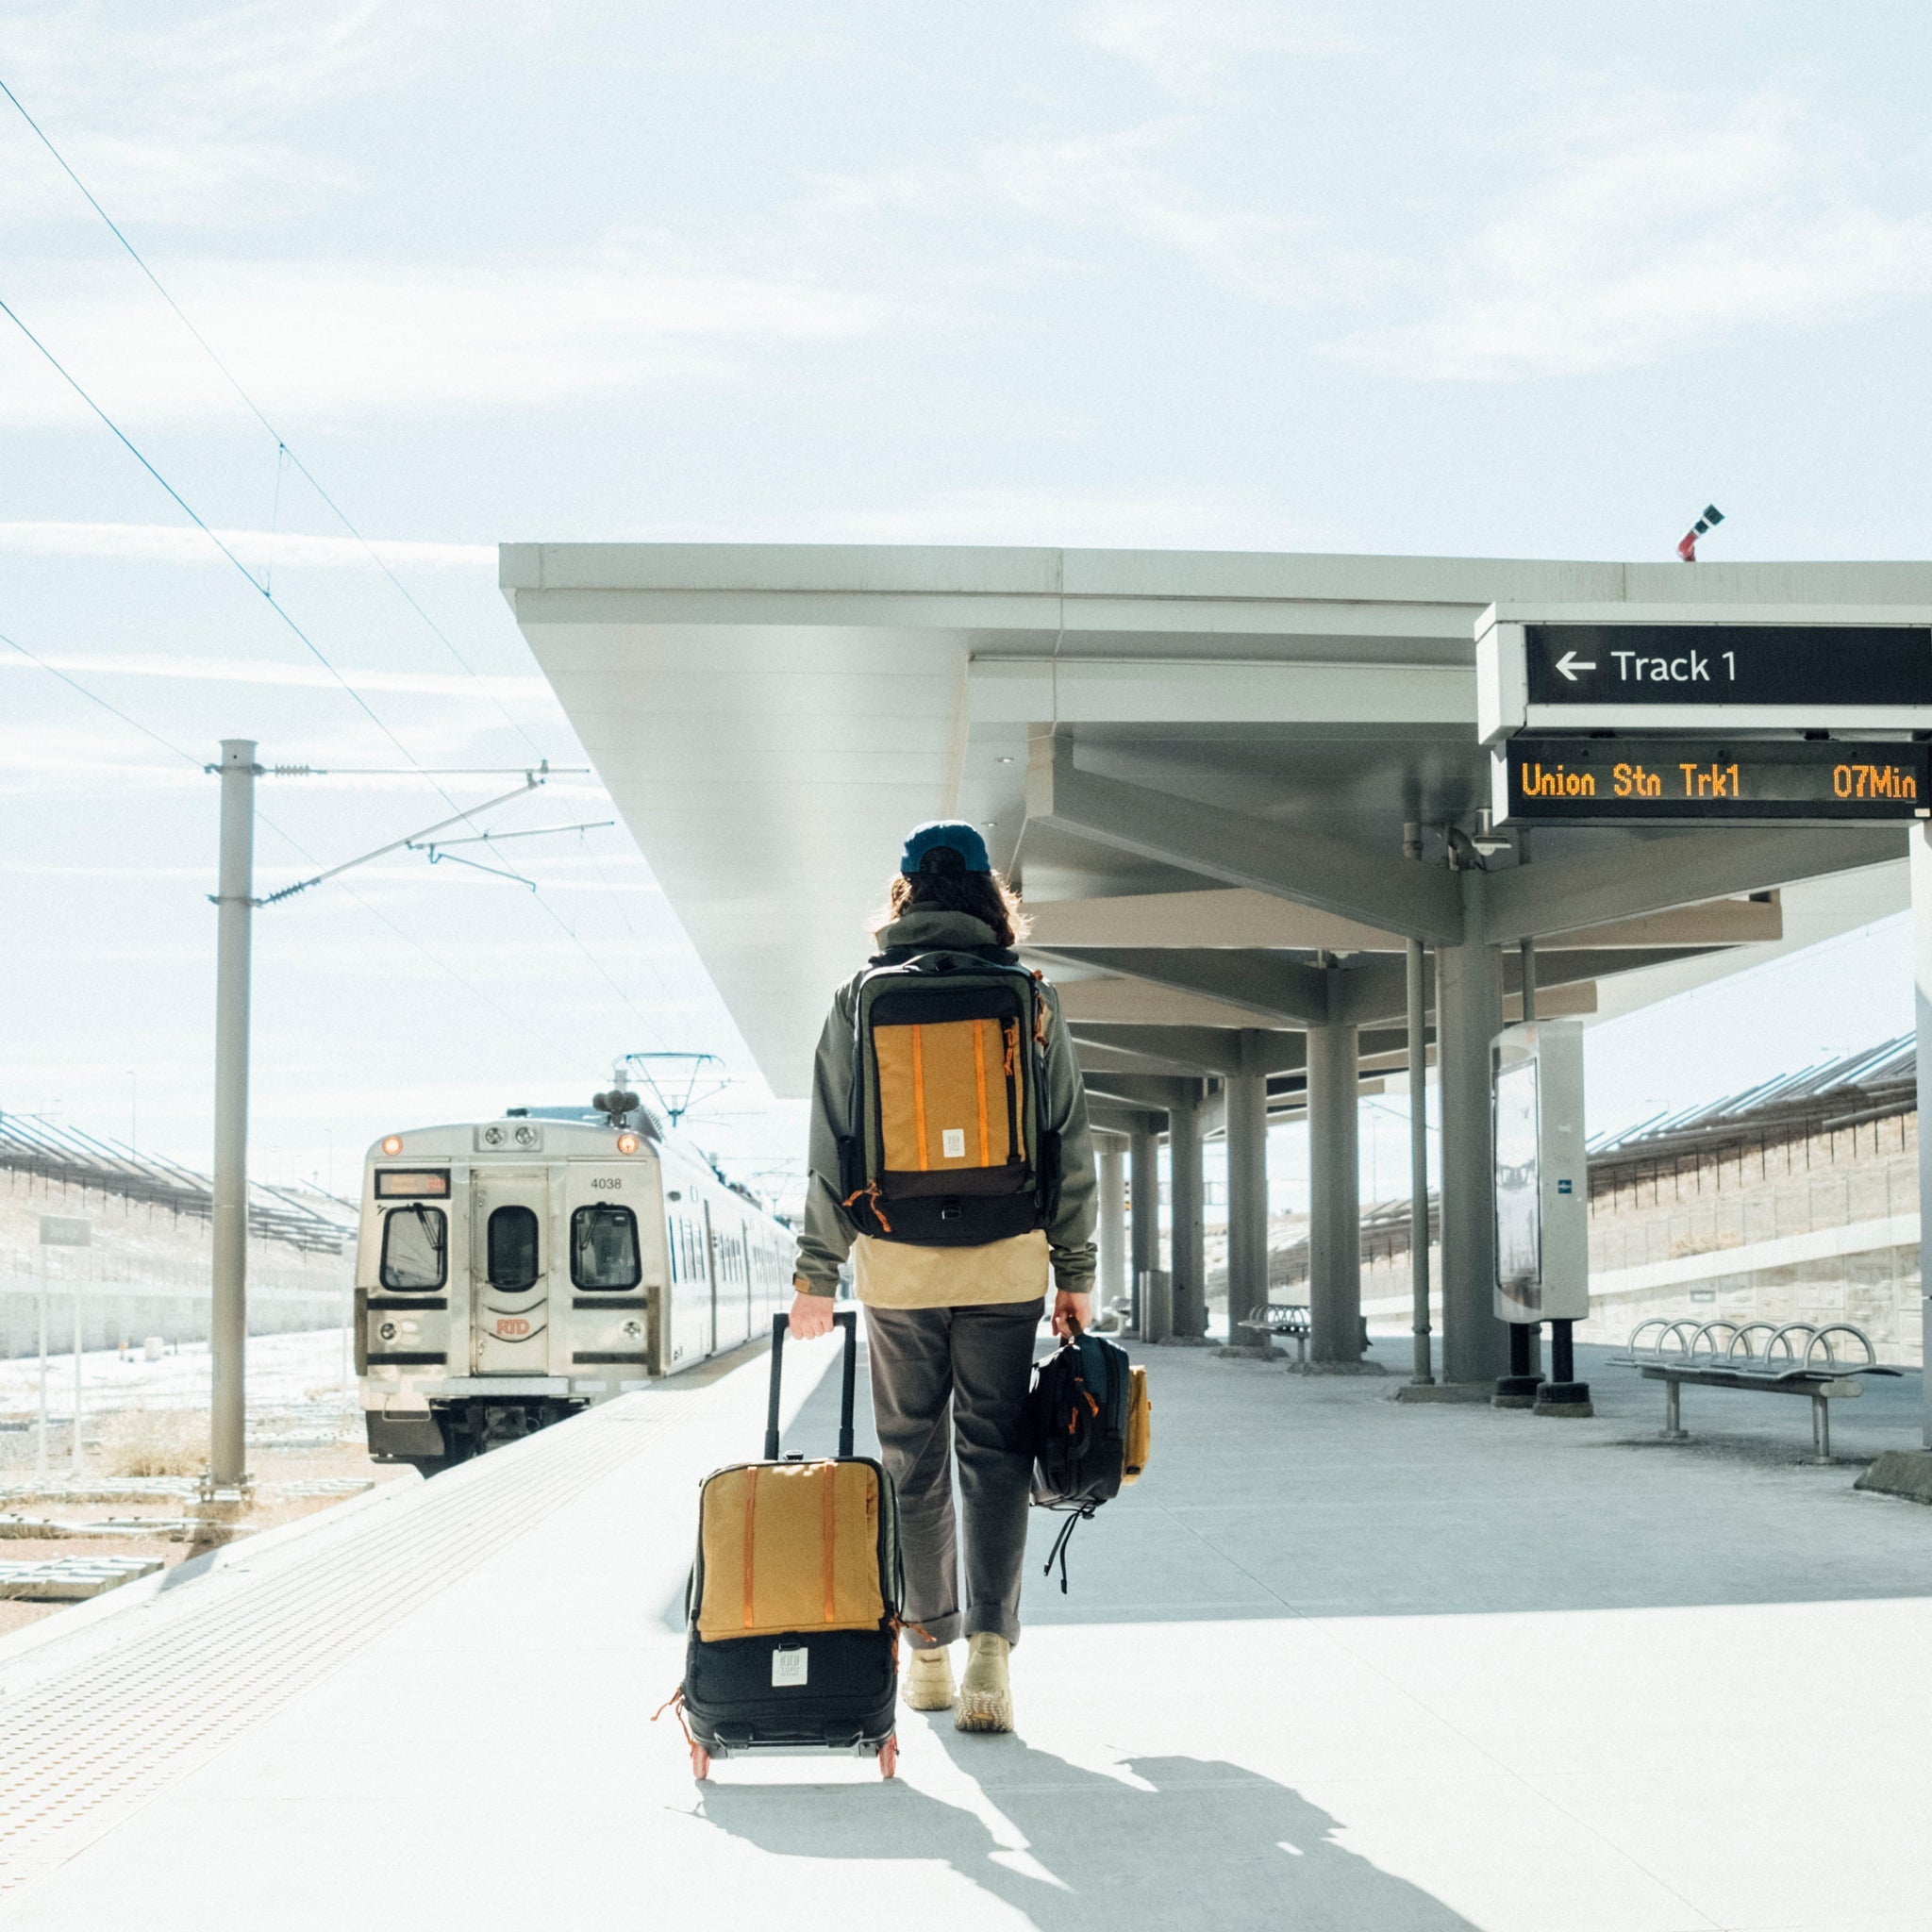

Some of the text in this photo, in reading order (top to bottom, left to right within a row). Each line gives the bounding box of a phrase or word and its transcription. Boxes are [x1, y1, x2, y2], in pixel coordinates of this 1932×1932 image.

[1610, 650, 1735, 681] Track 1
[1522, 762, 1917, 799] Union Stn Trk1 07Min
[591, 1178, 622, 1190] 4038
[496, 1319, 530, 1336] RTD
